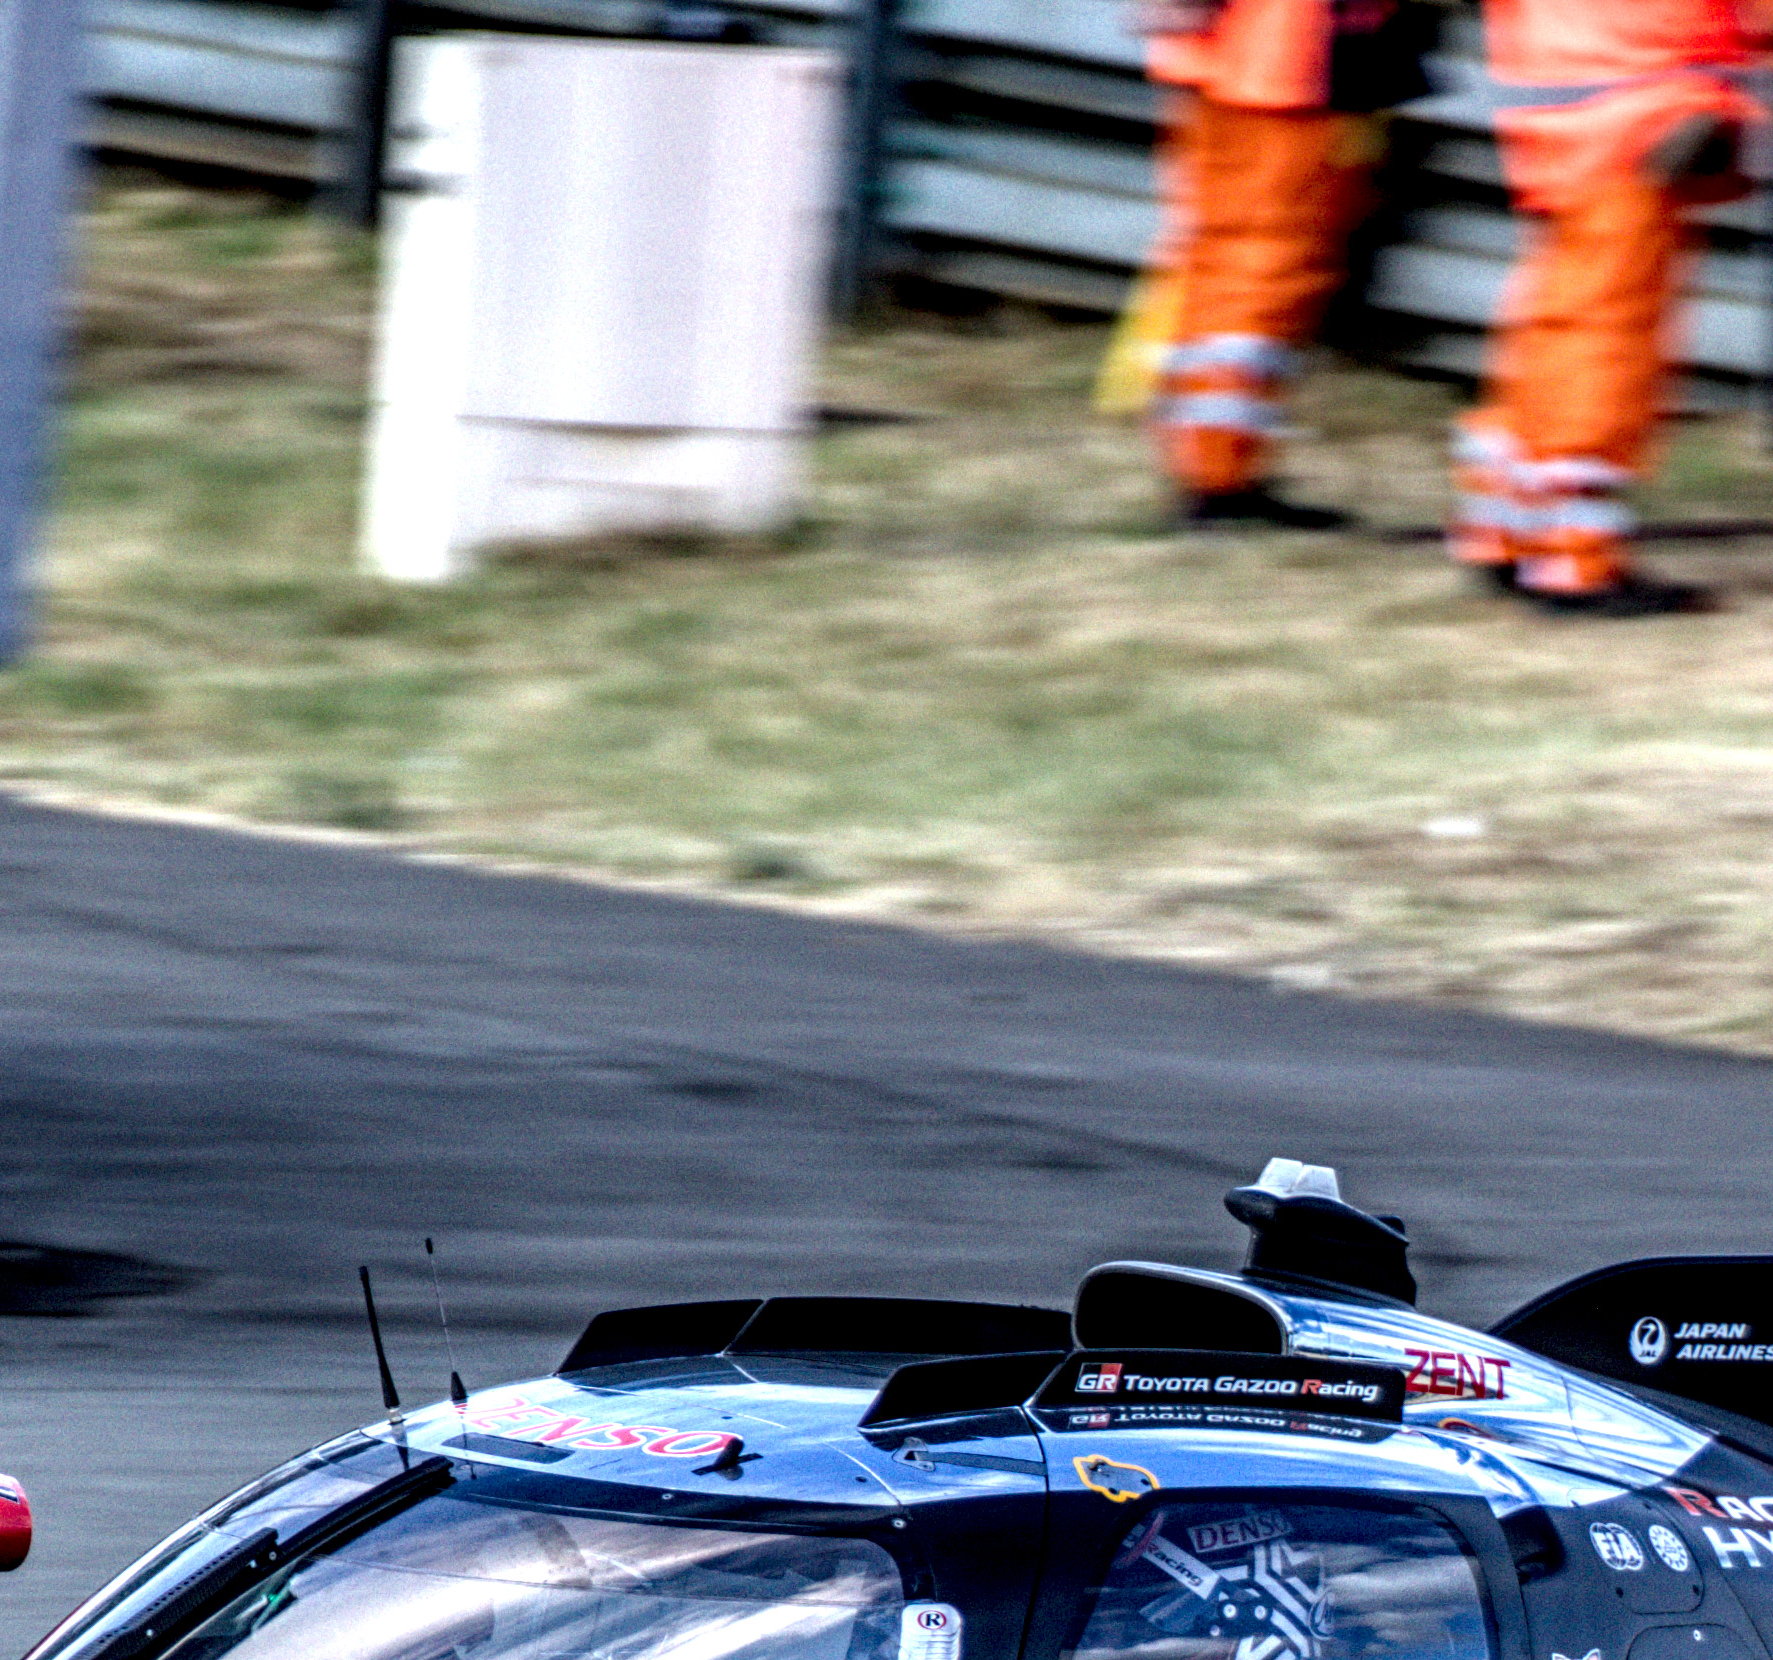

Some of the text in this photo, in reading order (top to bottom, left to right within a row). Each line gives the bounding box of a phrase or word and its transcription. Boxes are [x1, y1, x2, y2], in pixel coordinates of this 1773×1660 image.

[1674, 1322, 1747, 1339] JAPAN
[1079, 1374, 1378, 1402] GR TOYOTA GAZOO Racing
[1404, 1348, 1510, 1400] ZENT
[1592, 1532, 1640, 1560] FIA
